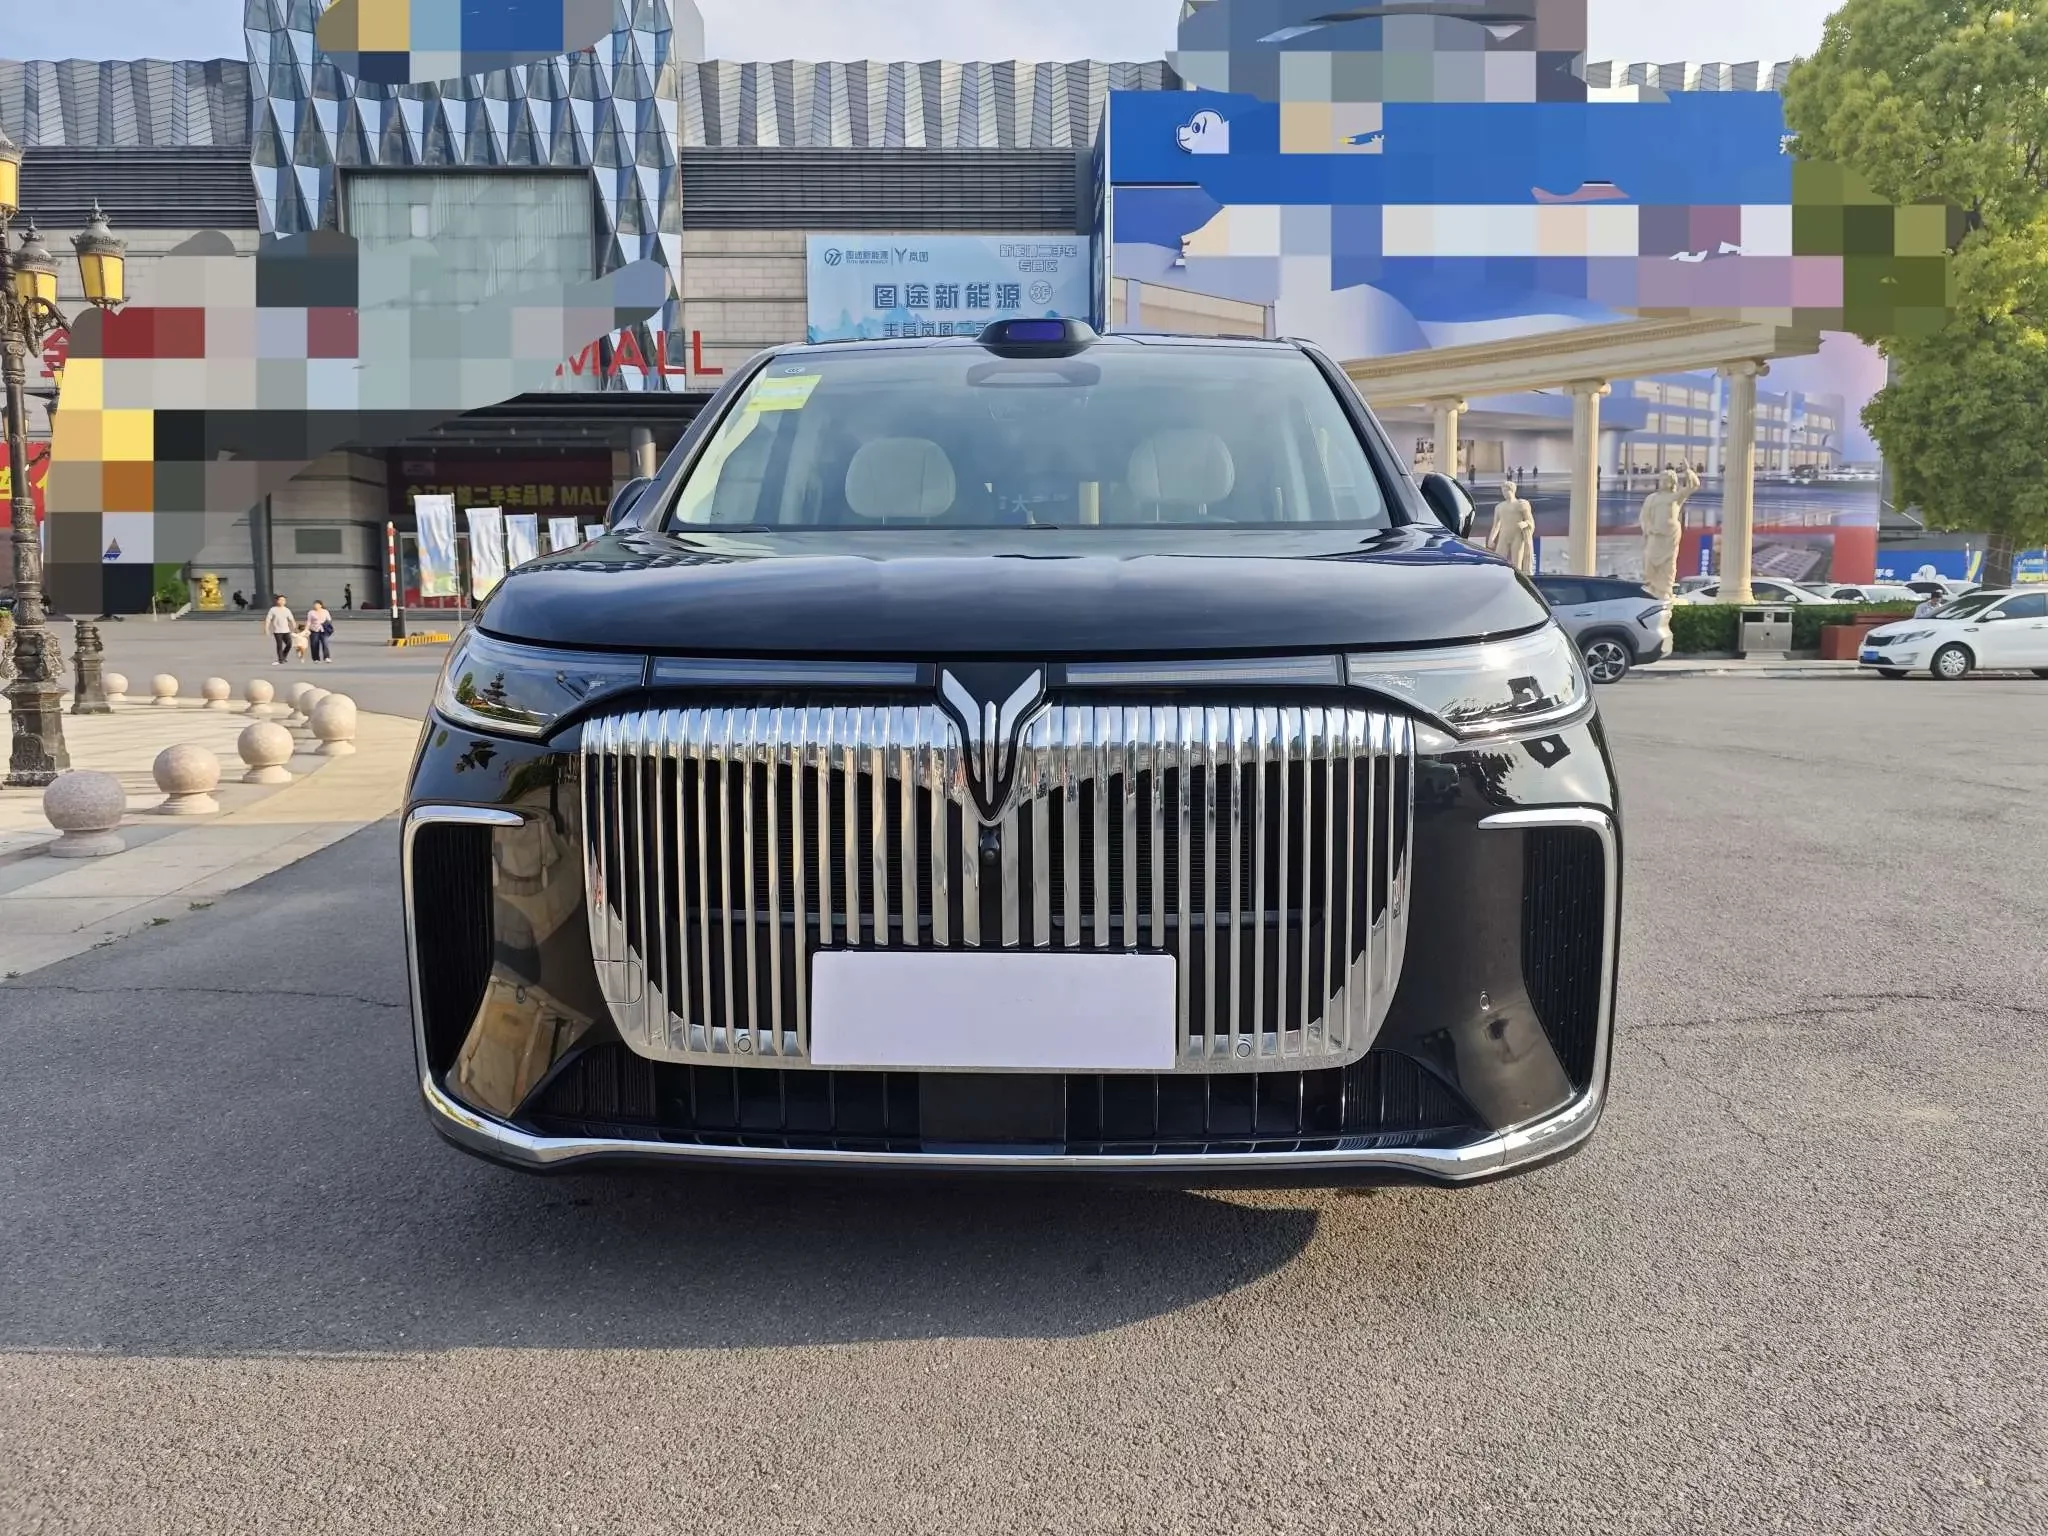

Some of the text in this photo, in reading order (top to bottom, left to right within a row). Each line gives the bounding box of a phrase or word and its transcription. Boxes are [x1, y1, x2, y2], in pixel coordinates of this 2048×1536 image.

[874, 284, 1021, 309] 图途新能源
[555, 330, 723, 376] MALL
